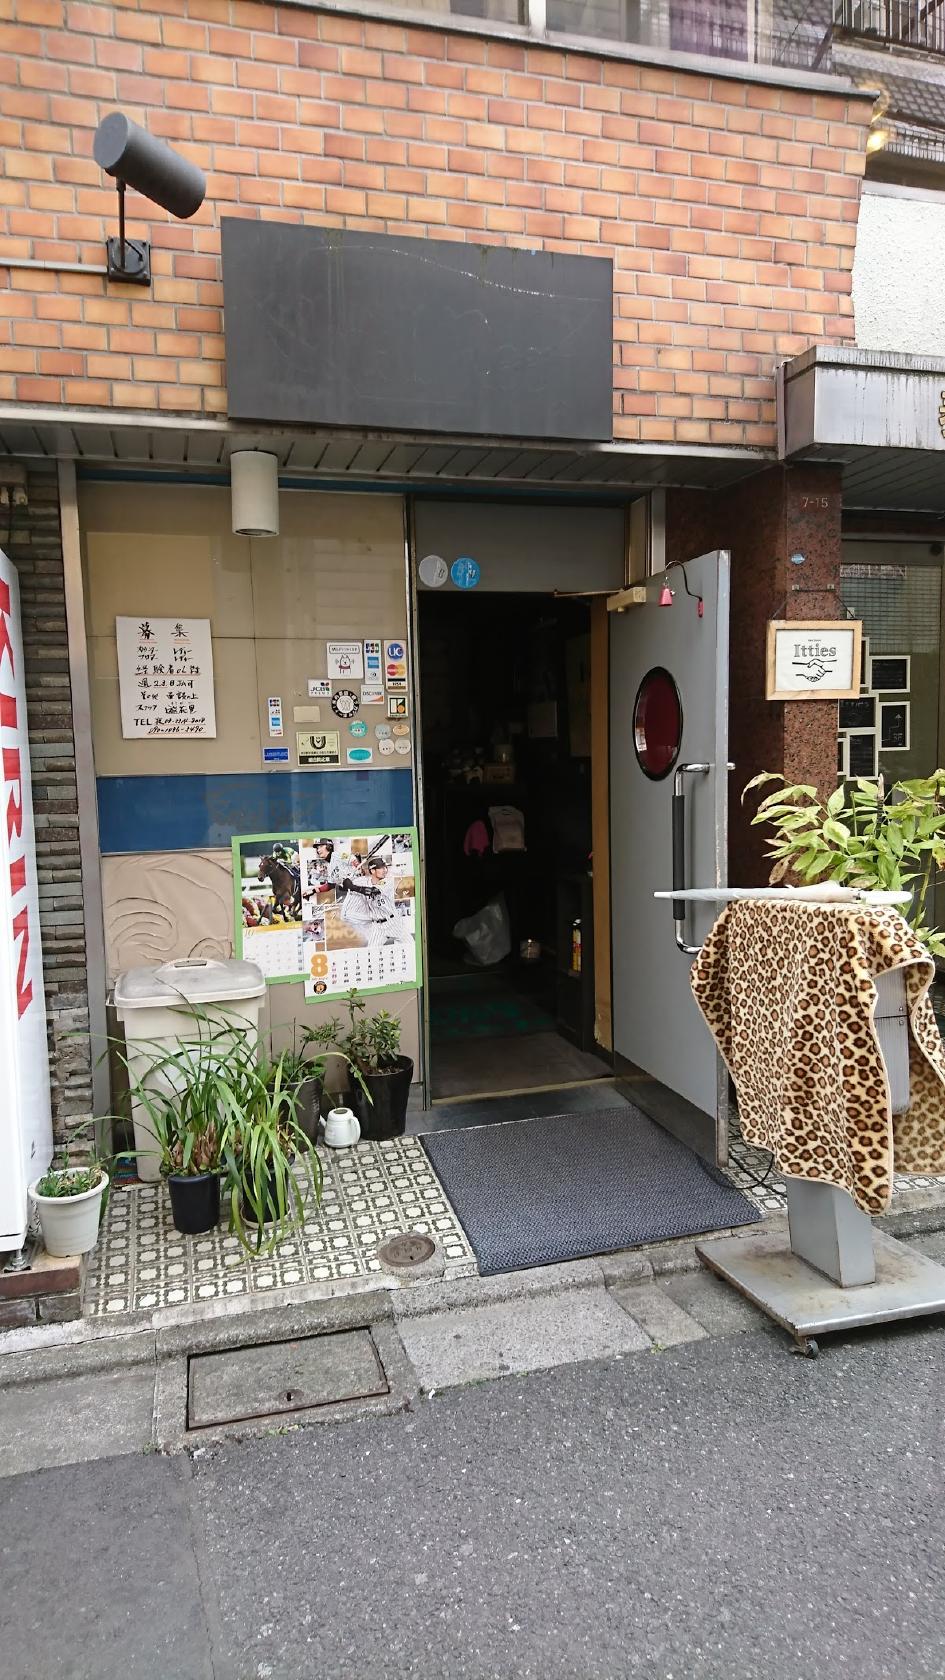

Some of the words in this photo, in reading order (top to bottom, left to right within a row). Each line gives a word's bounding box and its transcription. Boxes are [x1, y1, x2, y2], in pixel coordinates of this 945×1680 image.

[802, 496, 828, 508] 7-15
[388, 646, 403, 657] UC
[794, 643, 837, 658] Itties
[134, 718, 152, 726] TEL
[0, 578, 33, 1020] KIRIN
[311, 954, 328, 977] 8
